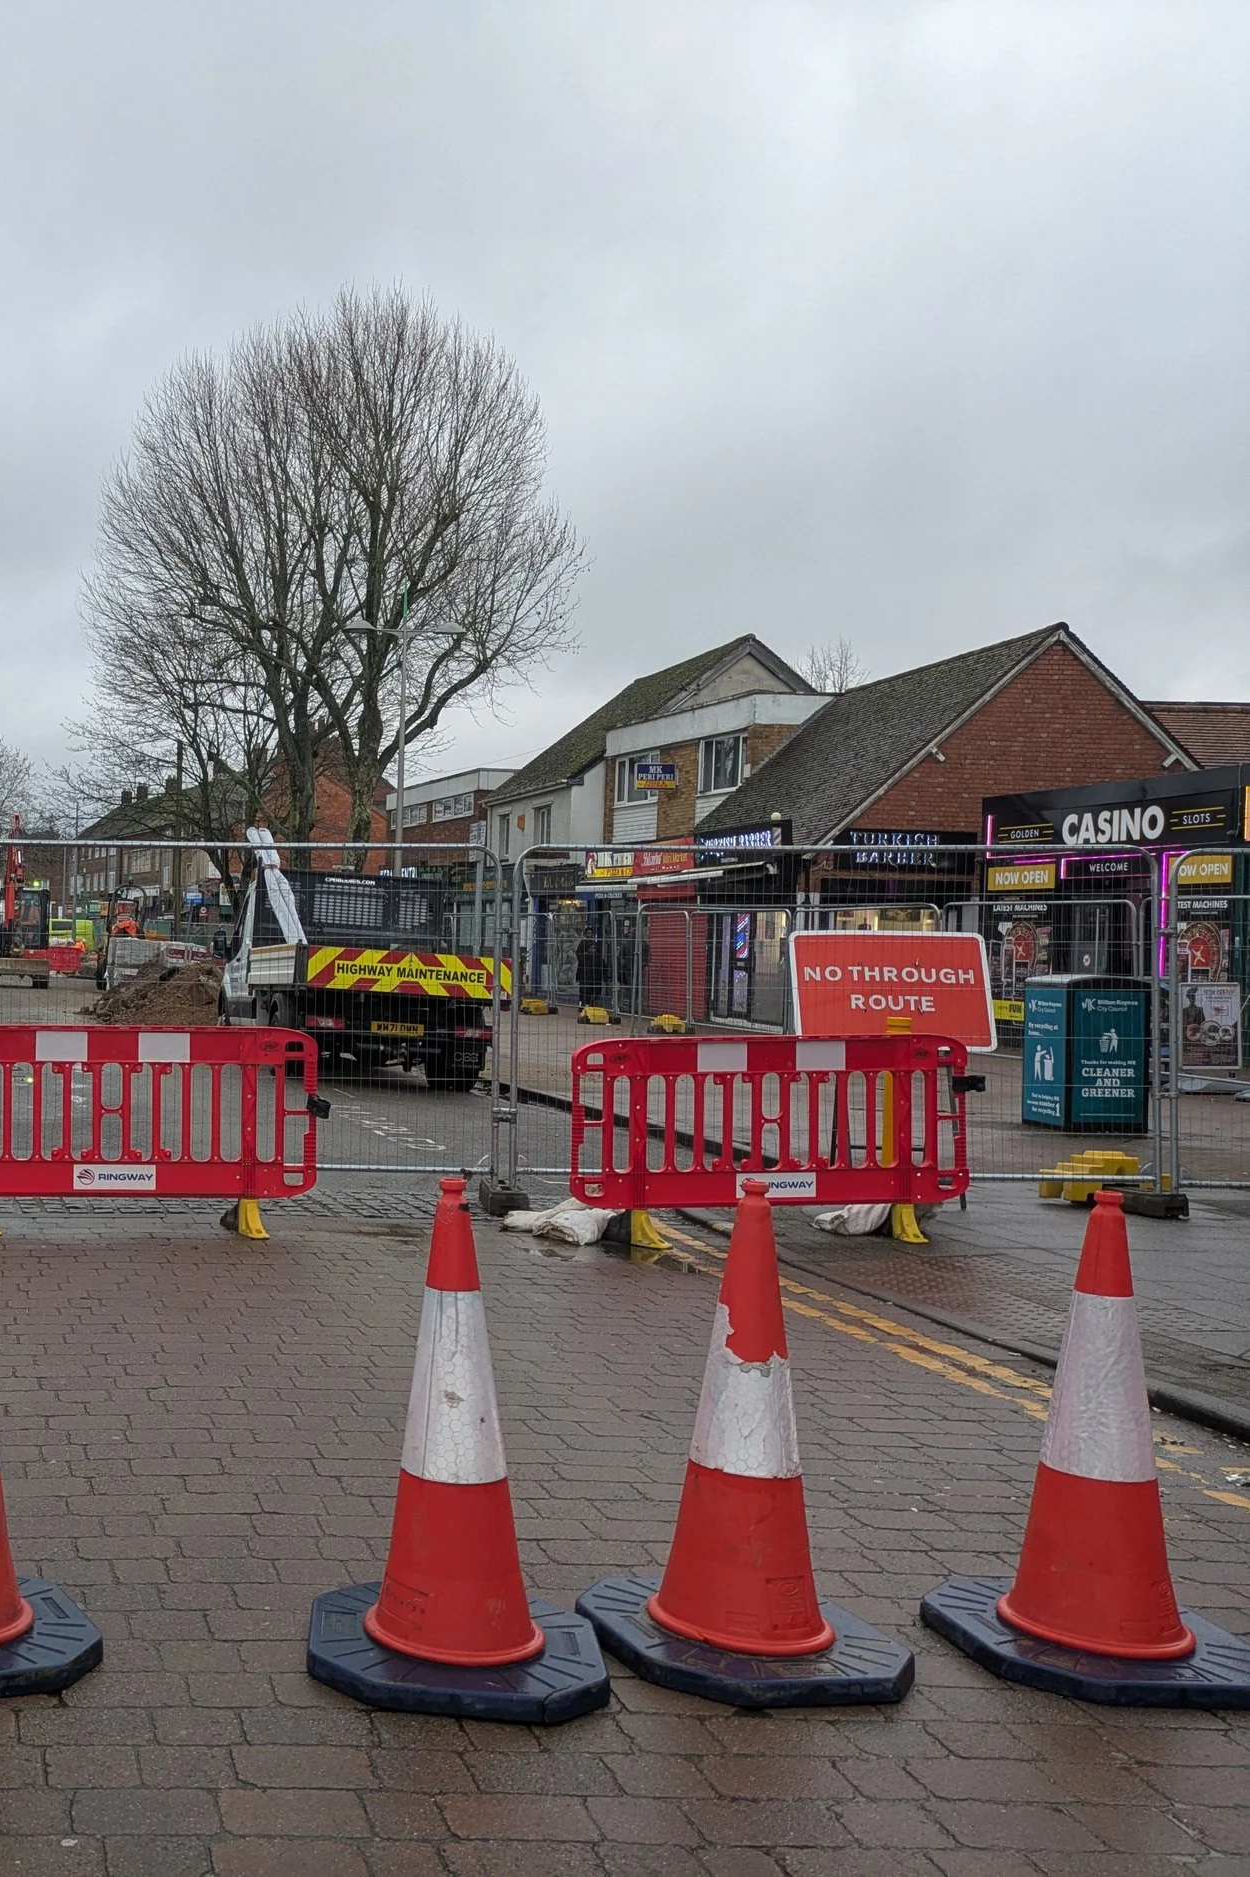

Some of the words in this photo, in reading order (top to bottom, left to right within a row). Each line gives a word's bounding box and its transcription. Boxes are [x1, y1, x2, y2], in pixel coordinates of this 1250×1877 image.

[1011, 829, 1039, 839] GOLDEN
[1062, 805, 1164, 845] CASINO
[1183, 813, 1210, 825] SLOTS
[850, 832, 940, 846] TURKISH
[856, 852, 937, 866] BARBER
[1089, 862, 1128, 873] WELCOME
[1179, 865, 1197, 877] OW
[1199, 863, 1228, 875] OPEN
[996, 872, 1020, 885] NOW
[1022, 870, 1048, 884] OPEN
[1178, 901, 1191, 909] TEST
[1192, 900, 1228, 909] MACHINES
[337, 963, 393, 977] HIGHWAY
[397, 966, 485, 984] MAINTENANCE
[804, 966, 842, 982] NO
[848, 966, 975, 984] THROUGH
[850, 994, 935, 1012] ROUTE
[1035, 1023, 1053, 1031] recycling
[1082, 1068, 1135, 1077] CLEANER
[1096, 1079, 1120, 1087] AND
[1082, 1088, 1135, 1097] GREENER
[1056, 1102, 1060, 1117] 1
[98, 1172, 154, 1182] RINGWAY
